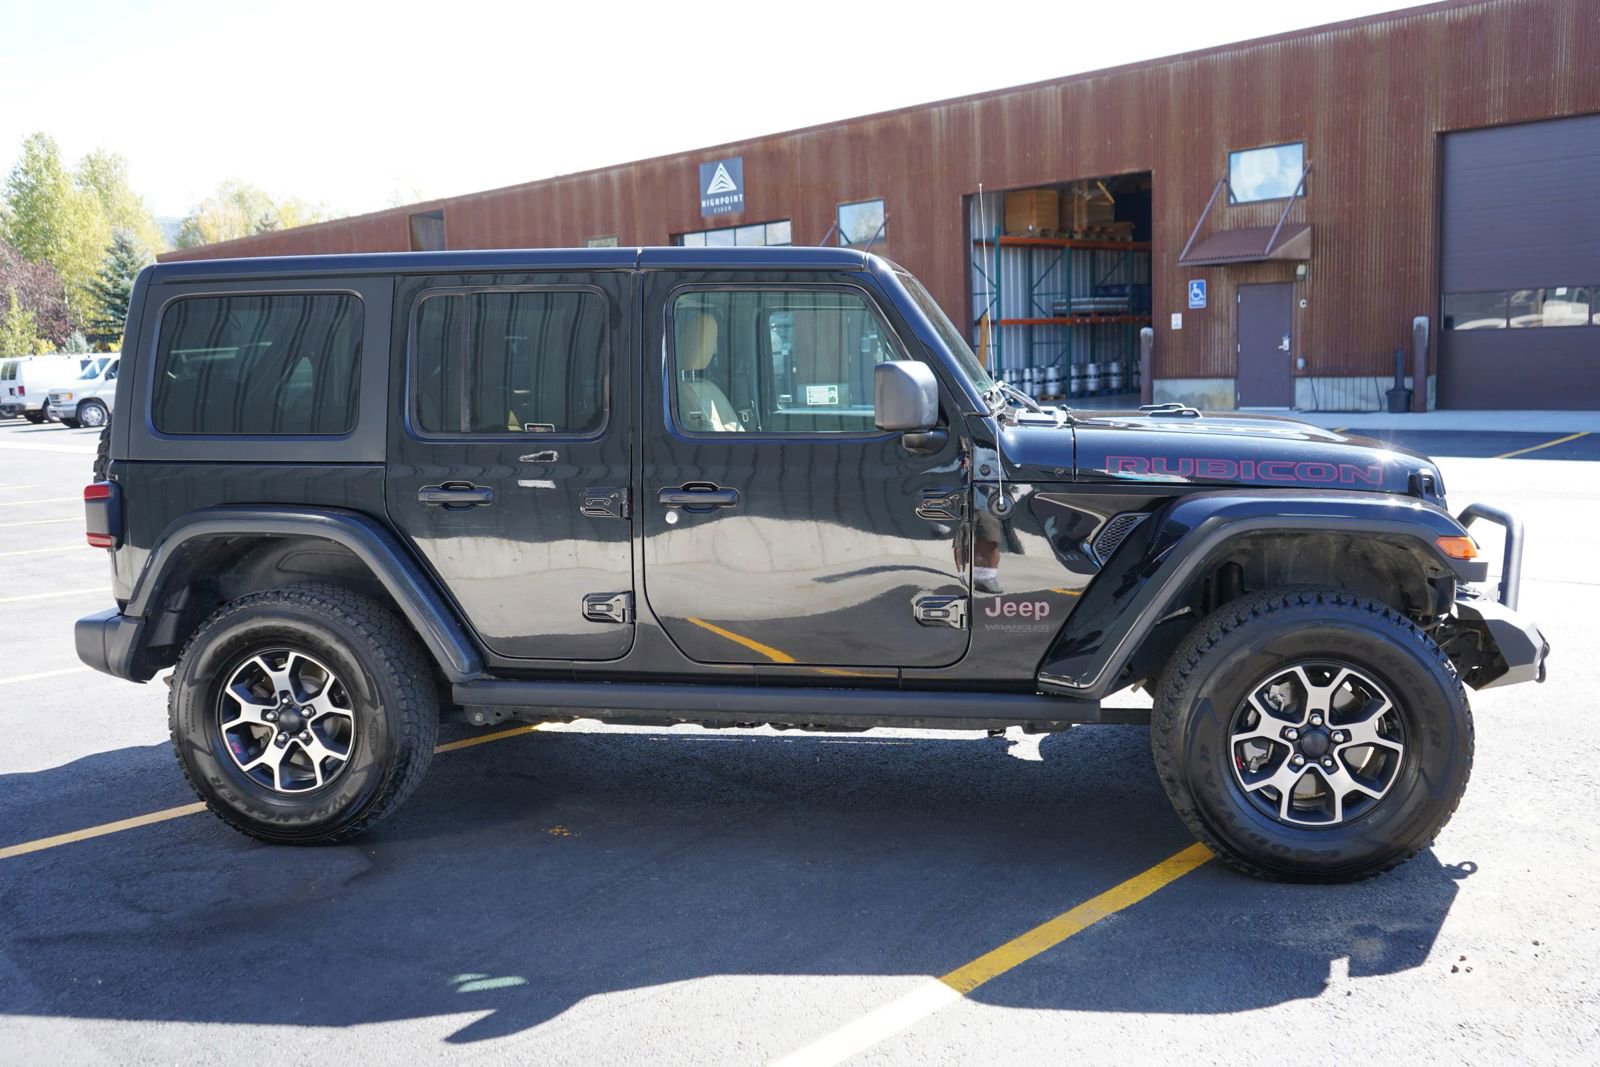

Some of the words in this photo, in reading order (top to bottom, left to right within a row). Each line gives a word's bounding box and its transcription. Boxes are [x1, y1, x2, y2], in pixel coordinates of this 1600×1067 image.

[701, 193, 744, 208] HIGHPOINT
[1104, 455, 1385, 485] RUBICON
[985, 597, 1050, 620] Jeep
[210, 775, 350, 823] WRANGLER
